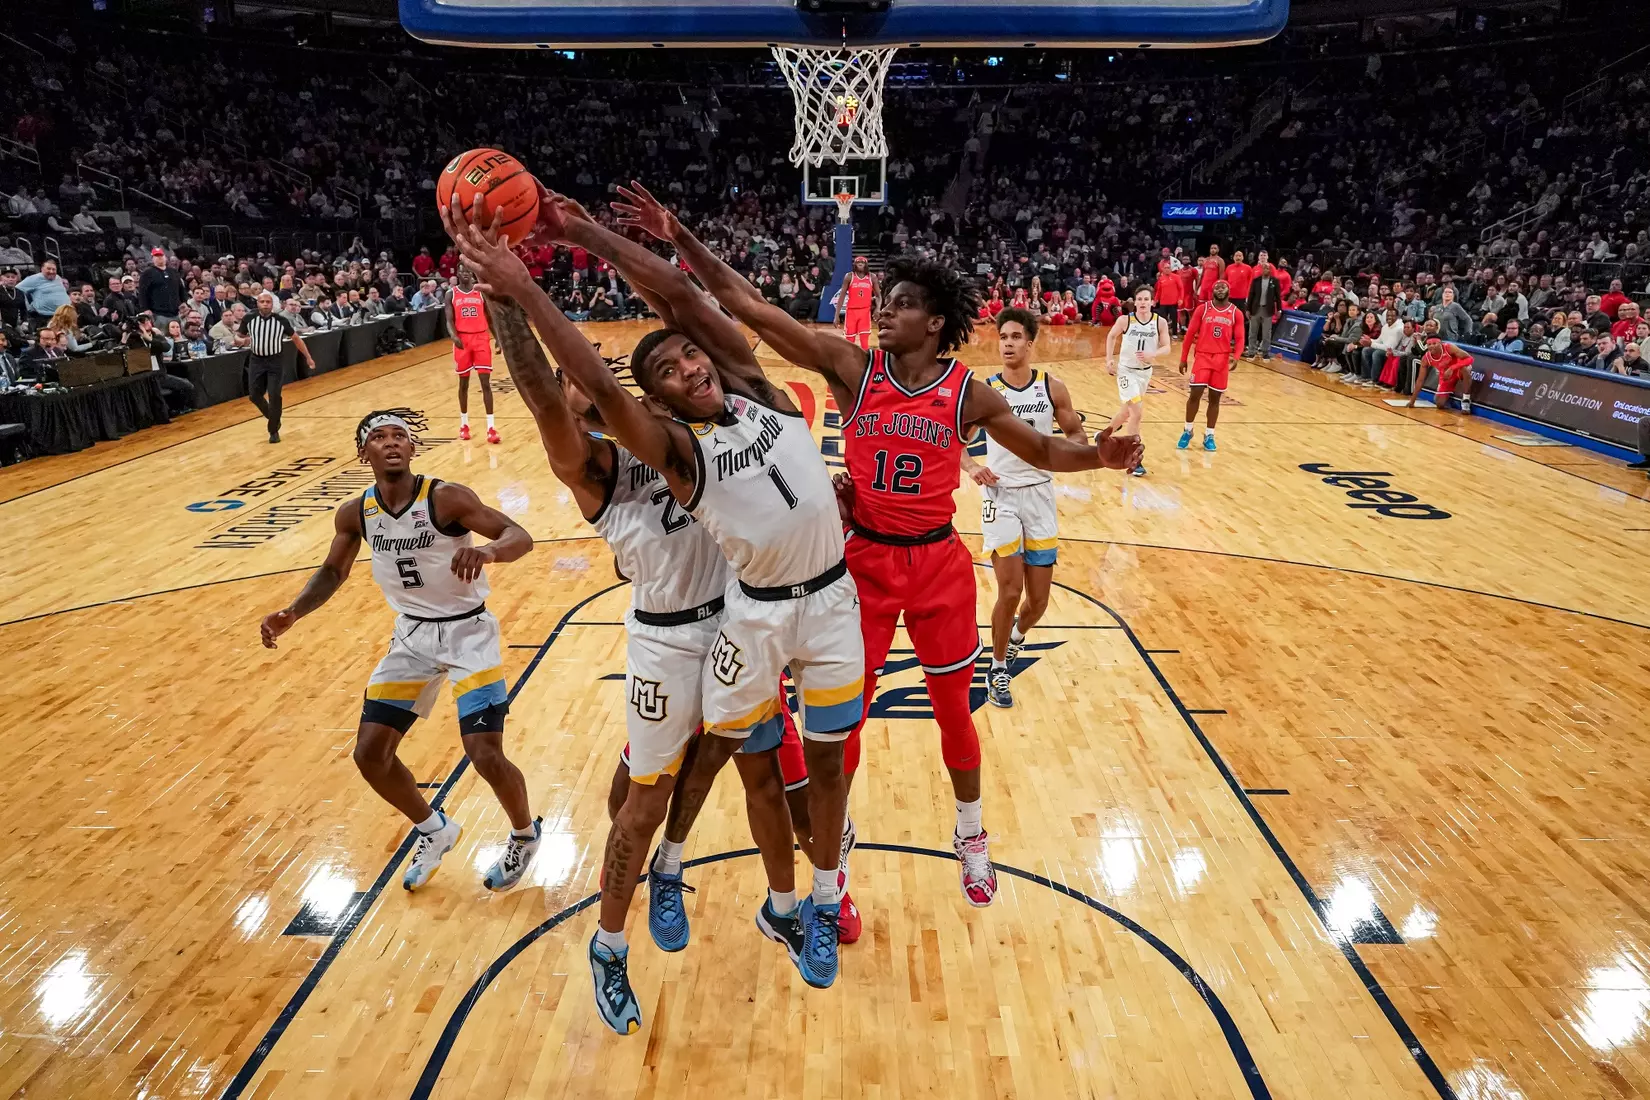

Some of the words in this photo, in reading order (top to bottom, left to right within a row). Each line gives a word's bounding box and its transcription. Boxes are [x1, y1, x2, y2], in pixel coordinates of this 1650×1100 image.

[1205, 206, 1237, 215] ULTRA
[461, 306, 478, 318] 22
[1137, 339, 1146, 351] 11
[1213, 326, 1223, 338] 5
[1537, 351, 1551, 360] POSS
[873, 374, 885, 382] JK
[1548, 389, 1560, 400] ON
[1560, 392, 1603, 411] LOCATION
[711, 413, 784, 482] Marquette
[855, 412, 880, 438] ST.
[883, 412, 954, 449] JOHN'S
[218, 456, 337, 497] CHASE
[768, 464, 798, 510] 1
[872, 450, 923, 495] 12
[1298, 463, 1452, 520] Jeep
[193, 505, 335, 549] GARDEN
[650, 486, 698, 535] 2
[371, 531, 435, 555] Marquette
[395, 557, 424, 589] 5
[712, 630, 744, 686] MU
[631, 675, 668, 722] MU
